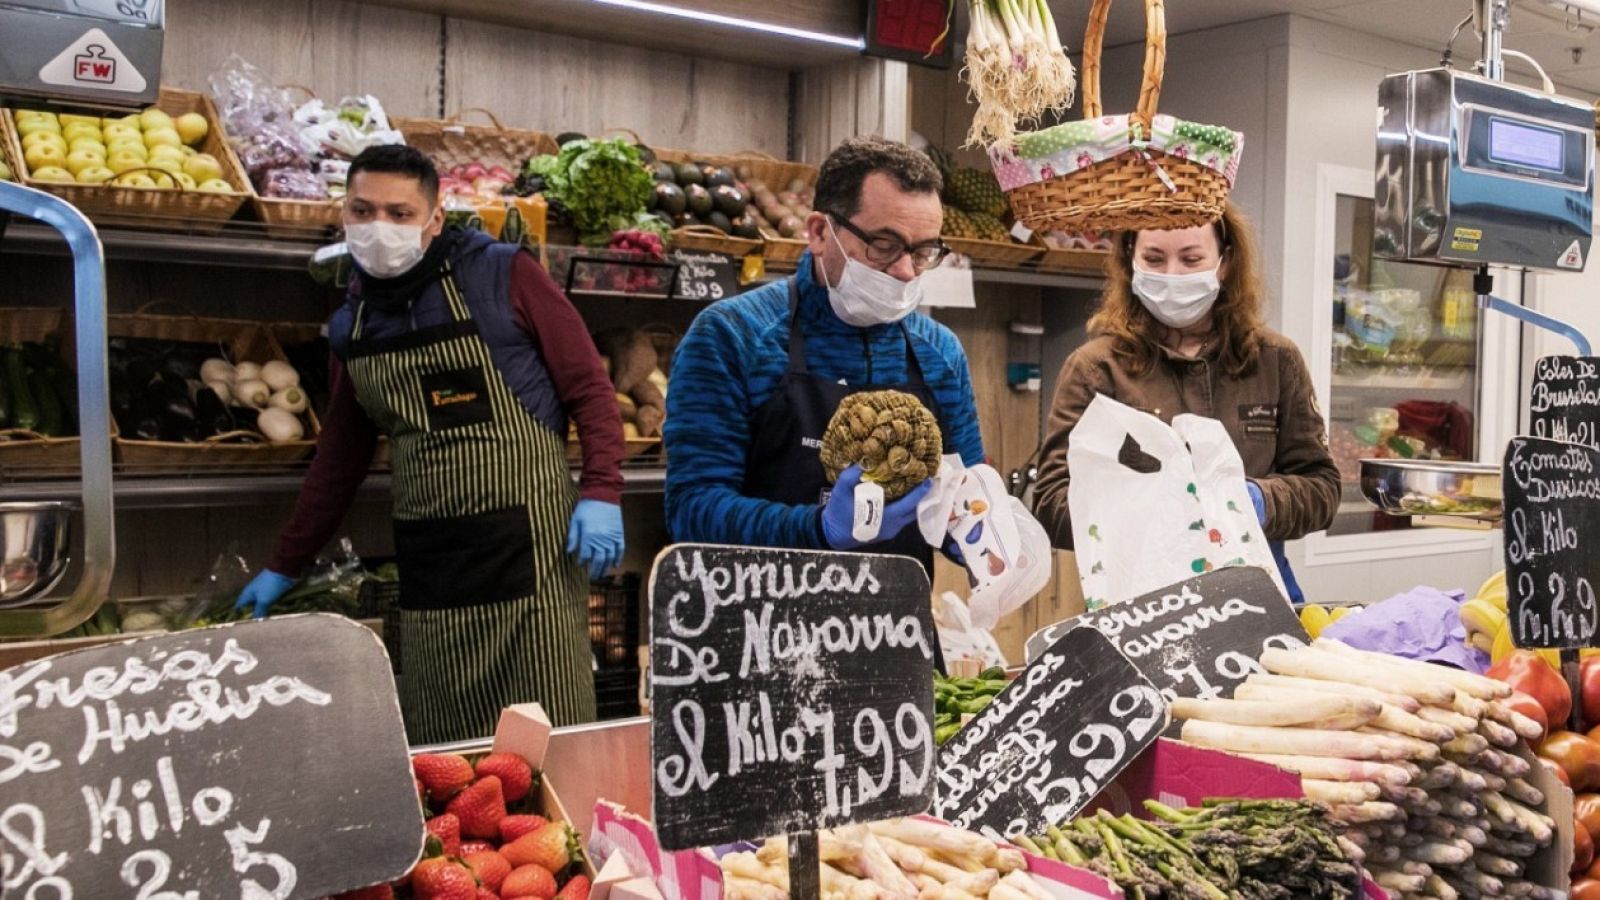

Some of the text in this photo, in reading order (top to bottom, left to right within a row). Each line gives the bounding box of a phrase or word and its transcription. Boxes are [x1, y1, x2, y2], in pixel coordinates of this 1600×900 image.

[78, 61, 112, 78] FW
[1538, 356, 1599, 380] Coles De
[1509, 439, 1593, 490] Tomates
[1509, 507, 1578, 565] el Kilo
[668, 550, 881, 637] Yemicas
[652, 602, 932, 686] De Navarra
[0, 638, 259, 738] Fresas
[77, 675, 333, 765] Huelva
[657, 690, 933, 817] el Kilo 7,99
[1024, 684, 1164, 826] 5,99
[82, 756, 234, 855] Kilo
